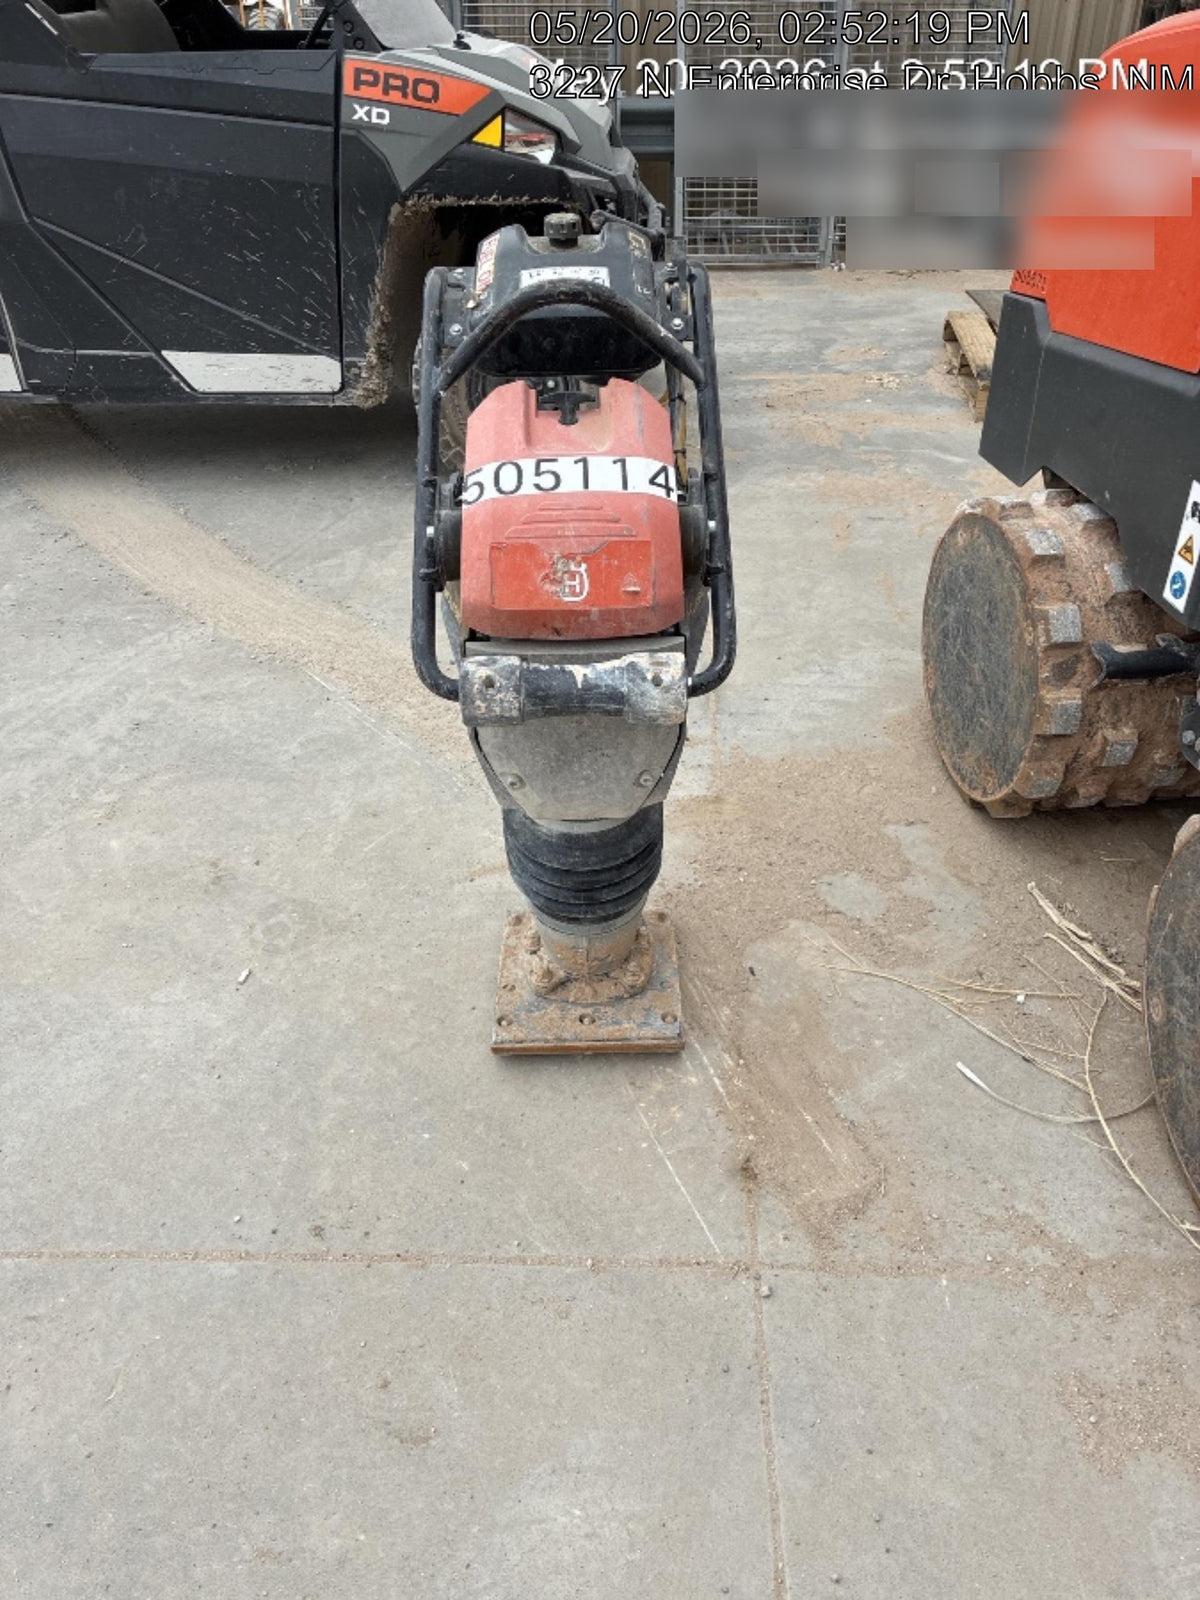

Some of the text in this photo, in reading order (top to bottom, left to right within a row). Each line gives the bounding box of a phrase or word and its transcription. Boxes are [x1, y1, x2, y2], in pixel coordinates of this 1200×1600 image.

[353, 67, 440, 103] PRO
[351, 103, 390, 125] XD
[460, 456, 676, 505] 505114
